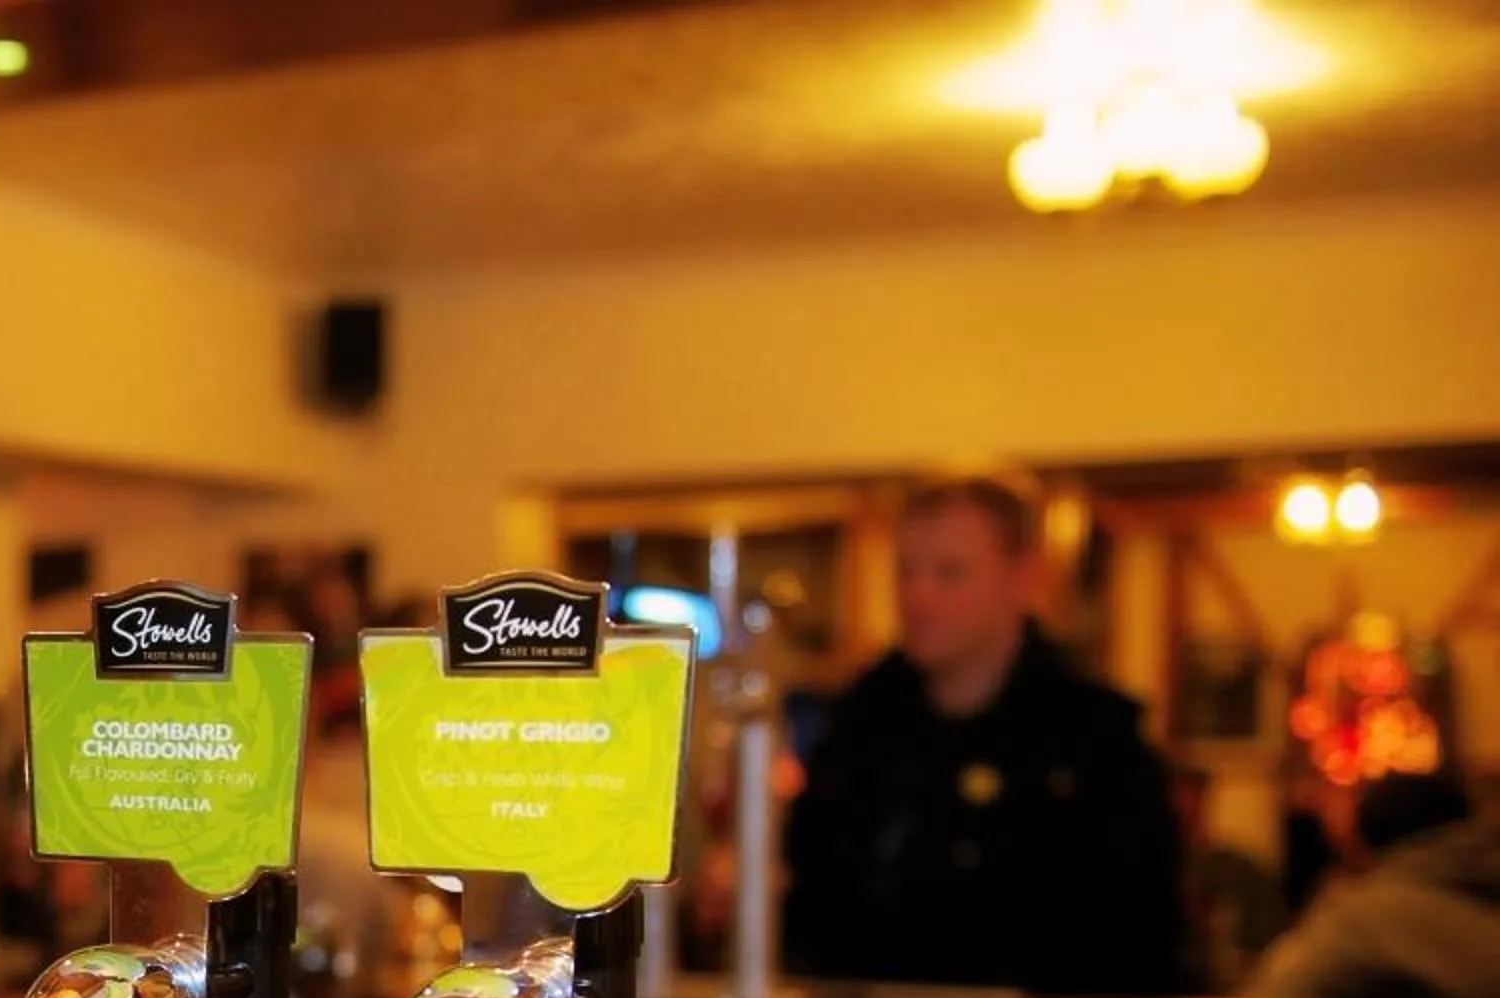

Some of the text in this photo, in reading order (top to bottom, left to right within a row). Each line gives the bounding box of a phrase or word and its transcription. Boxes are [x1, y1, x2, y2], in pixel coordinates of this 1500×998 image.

[111, 606, 213, 657] Stowells
[463, 598, 581, 655] Stowells
[500, 646, 587, 658] TASTE THE WORLD
[92, 720, 234, 742] COLOMBARD
[435, 721, 611, 743] PINOT GRIGIO
[81, 739, 243, 761] CHARDONNAY
[174, 768, 197, 786] Dry
[203, 771, 214, 784] &
[220, 771, 258, 788] Fruity
[110, 795, 213, 812] AUSTRALIA
[491, 801, 550, 818] ITALY
